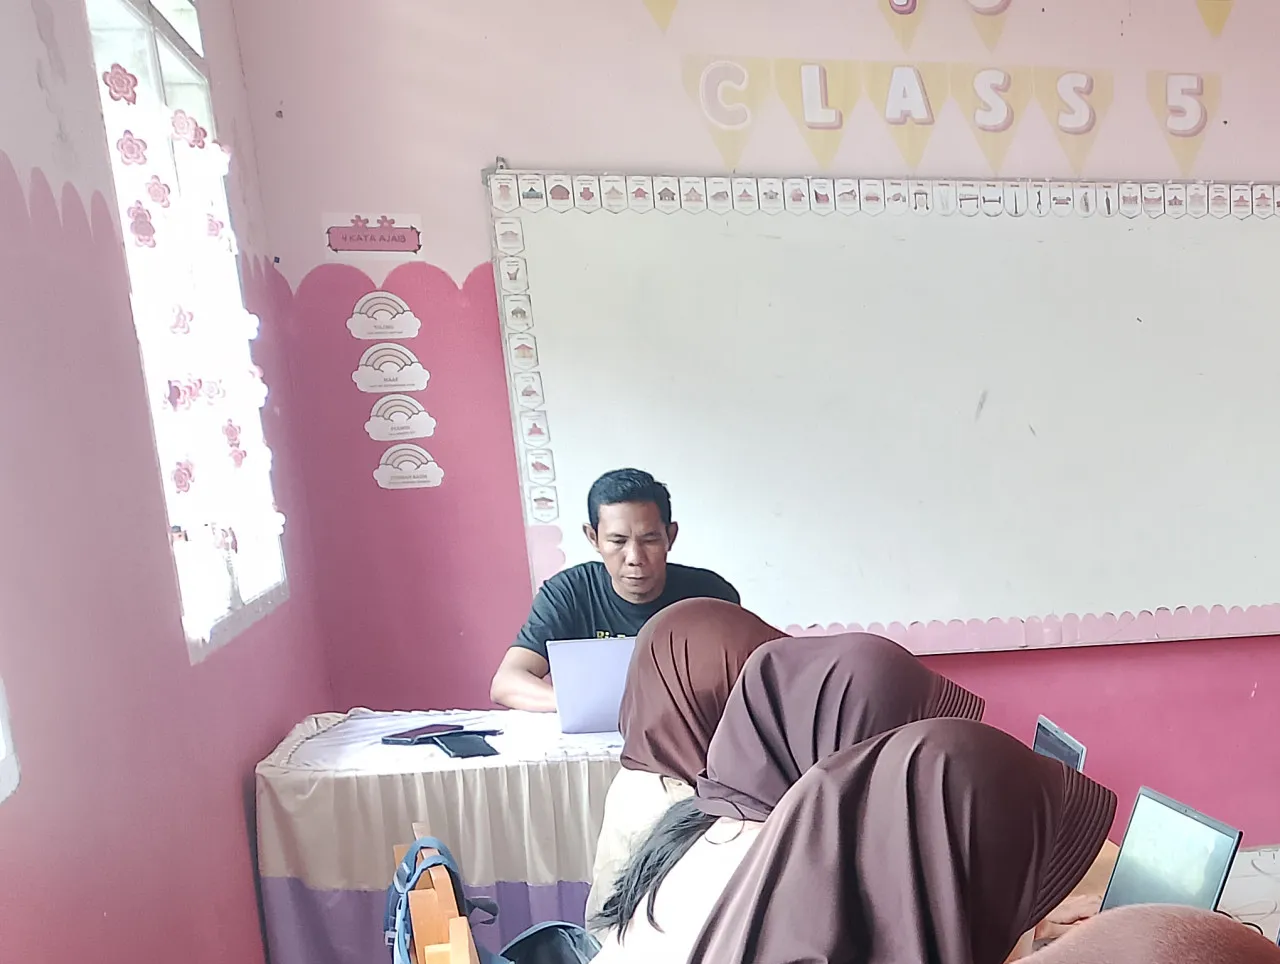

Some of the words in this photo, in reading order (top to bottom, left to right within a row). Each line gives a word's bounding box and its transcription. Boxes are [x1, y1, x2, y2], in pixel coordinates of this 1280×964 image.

[700, 60, 1096, 134] CLASS
[1165, 71, 1208, 137] 5
[349, 234, 376, 242] KATA
